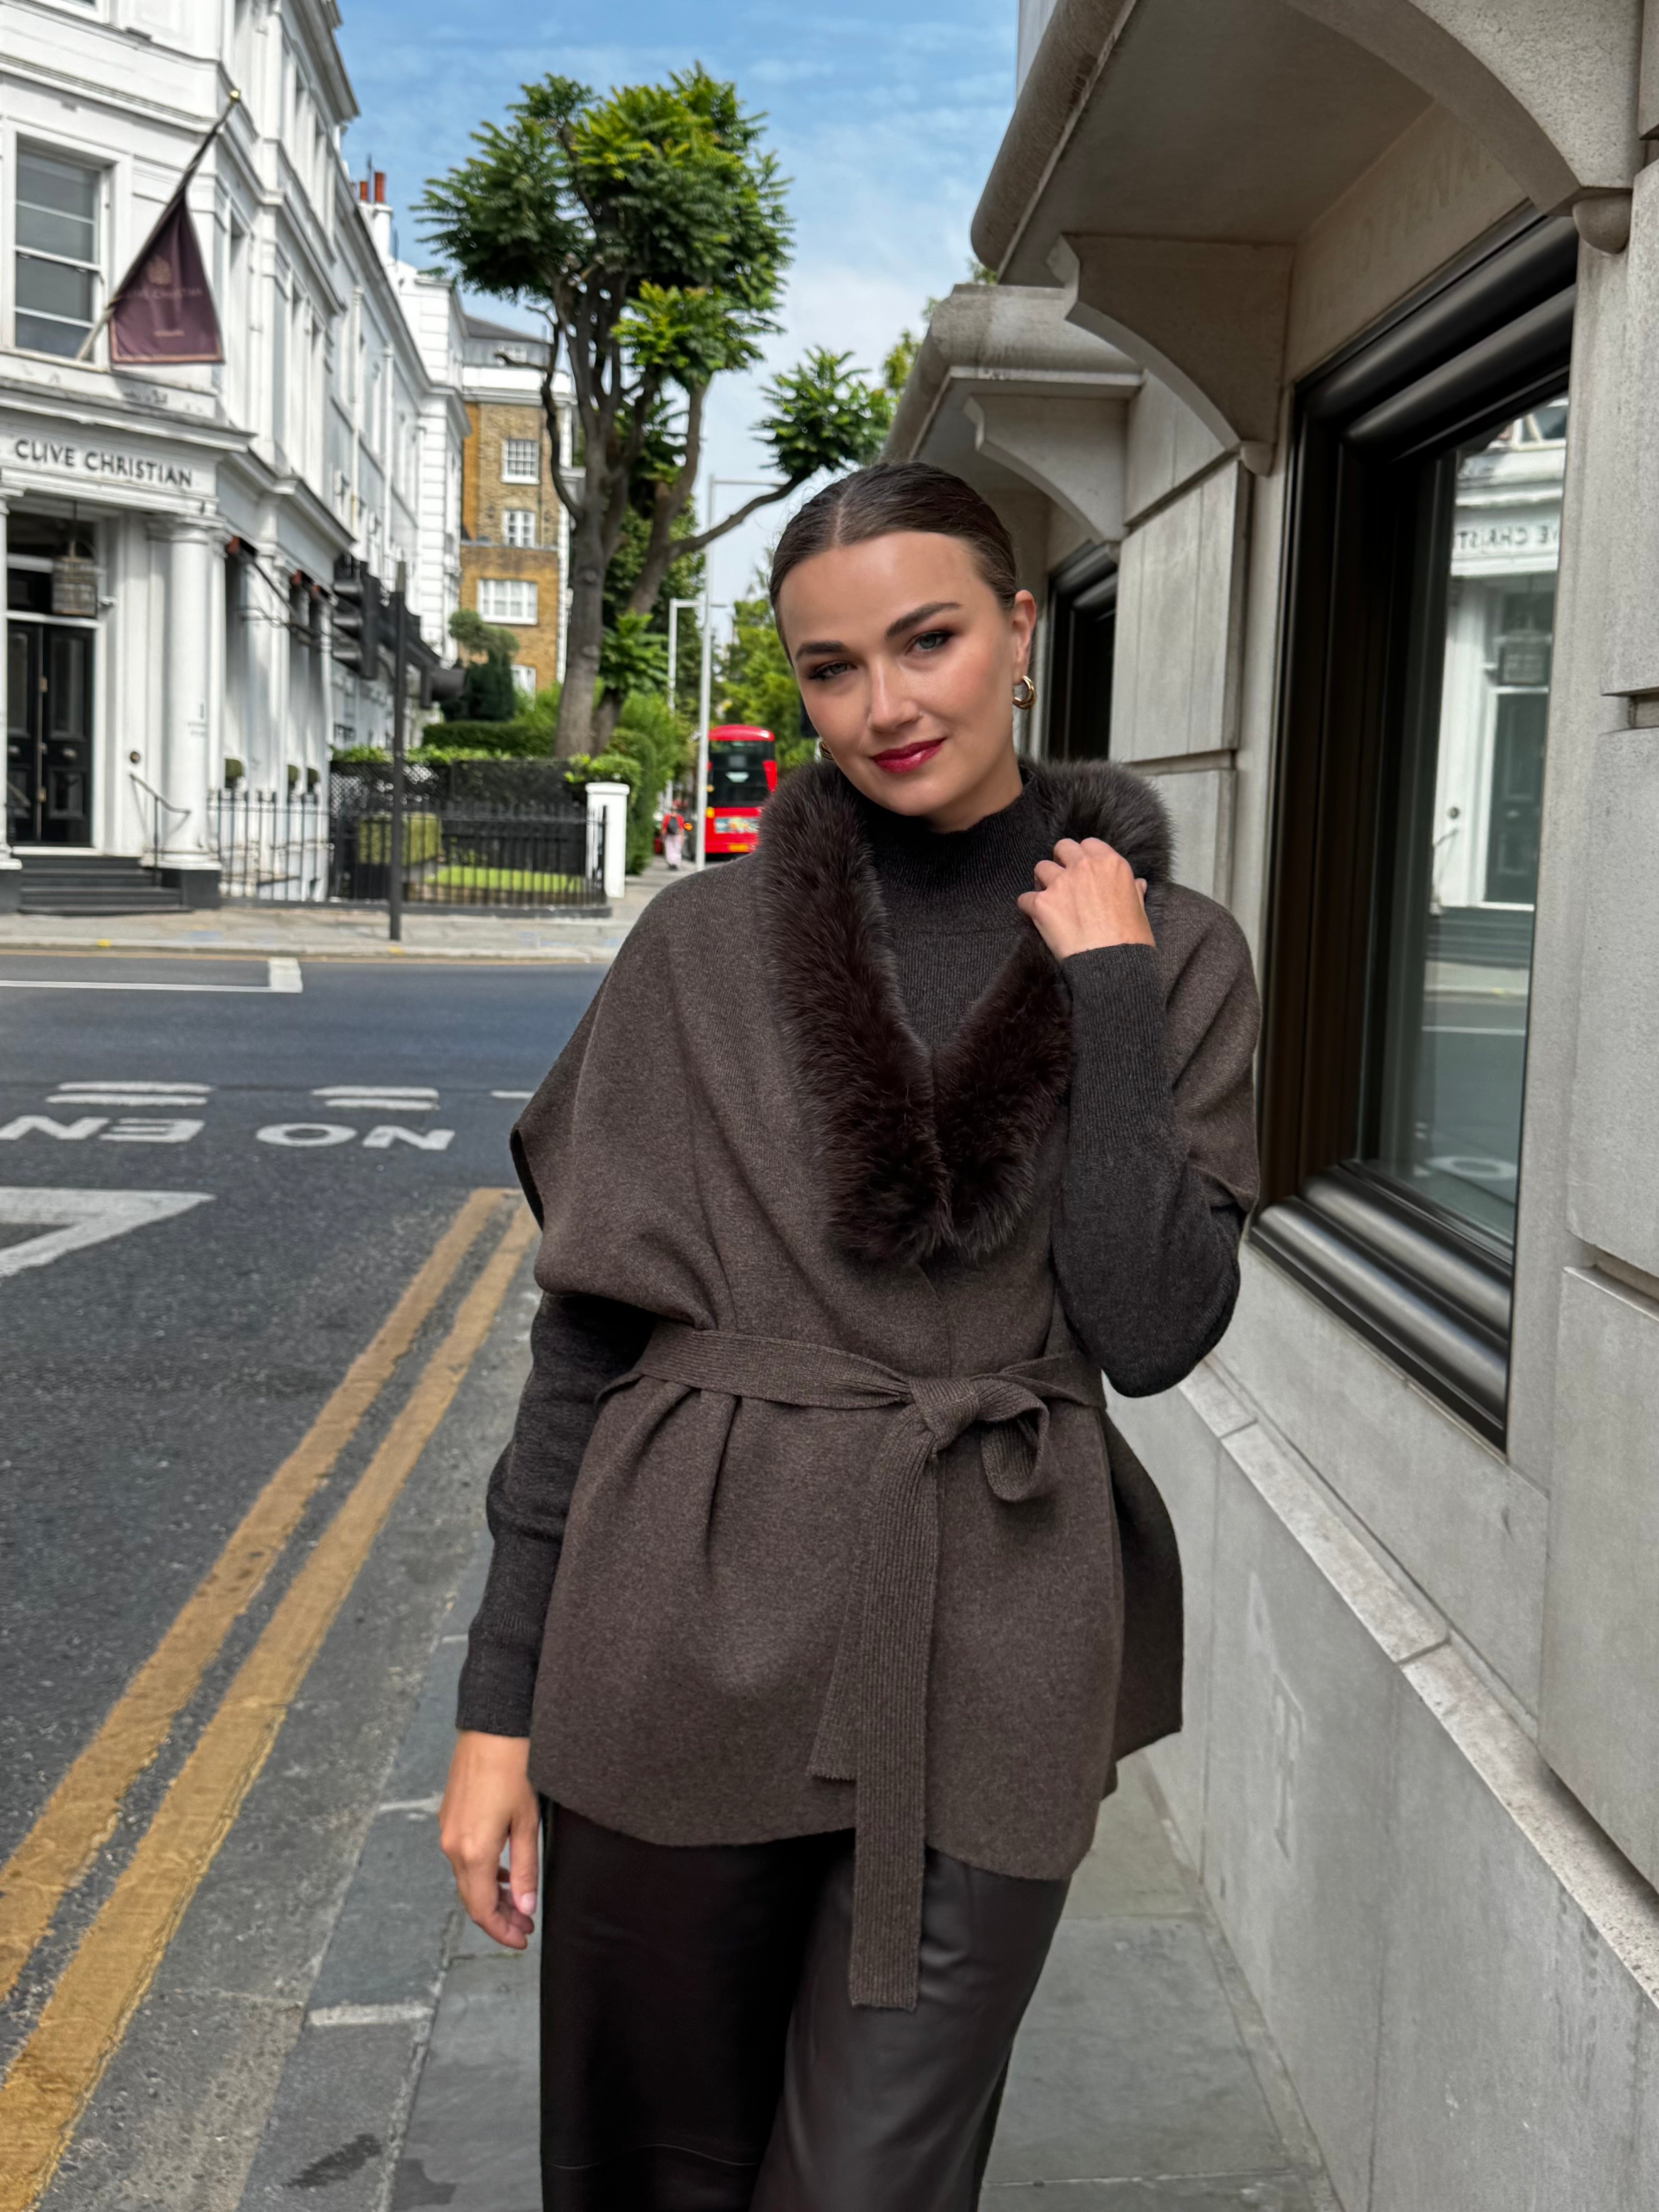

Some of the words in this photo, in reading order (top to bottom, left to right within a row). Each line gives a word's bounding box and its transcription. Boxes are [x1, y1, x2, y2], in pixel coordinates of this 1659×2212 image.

[15, 438, 75, 467] CLIVE
[85, 451, 192, 487] CHRISTIAN
[256, 1122, 455, 1150] NO
